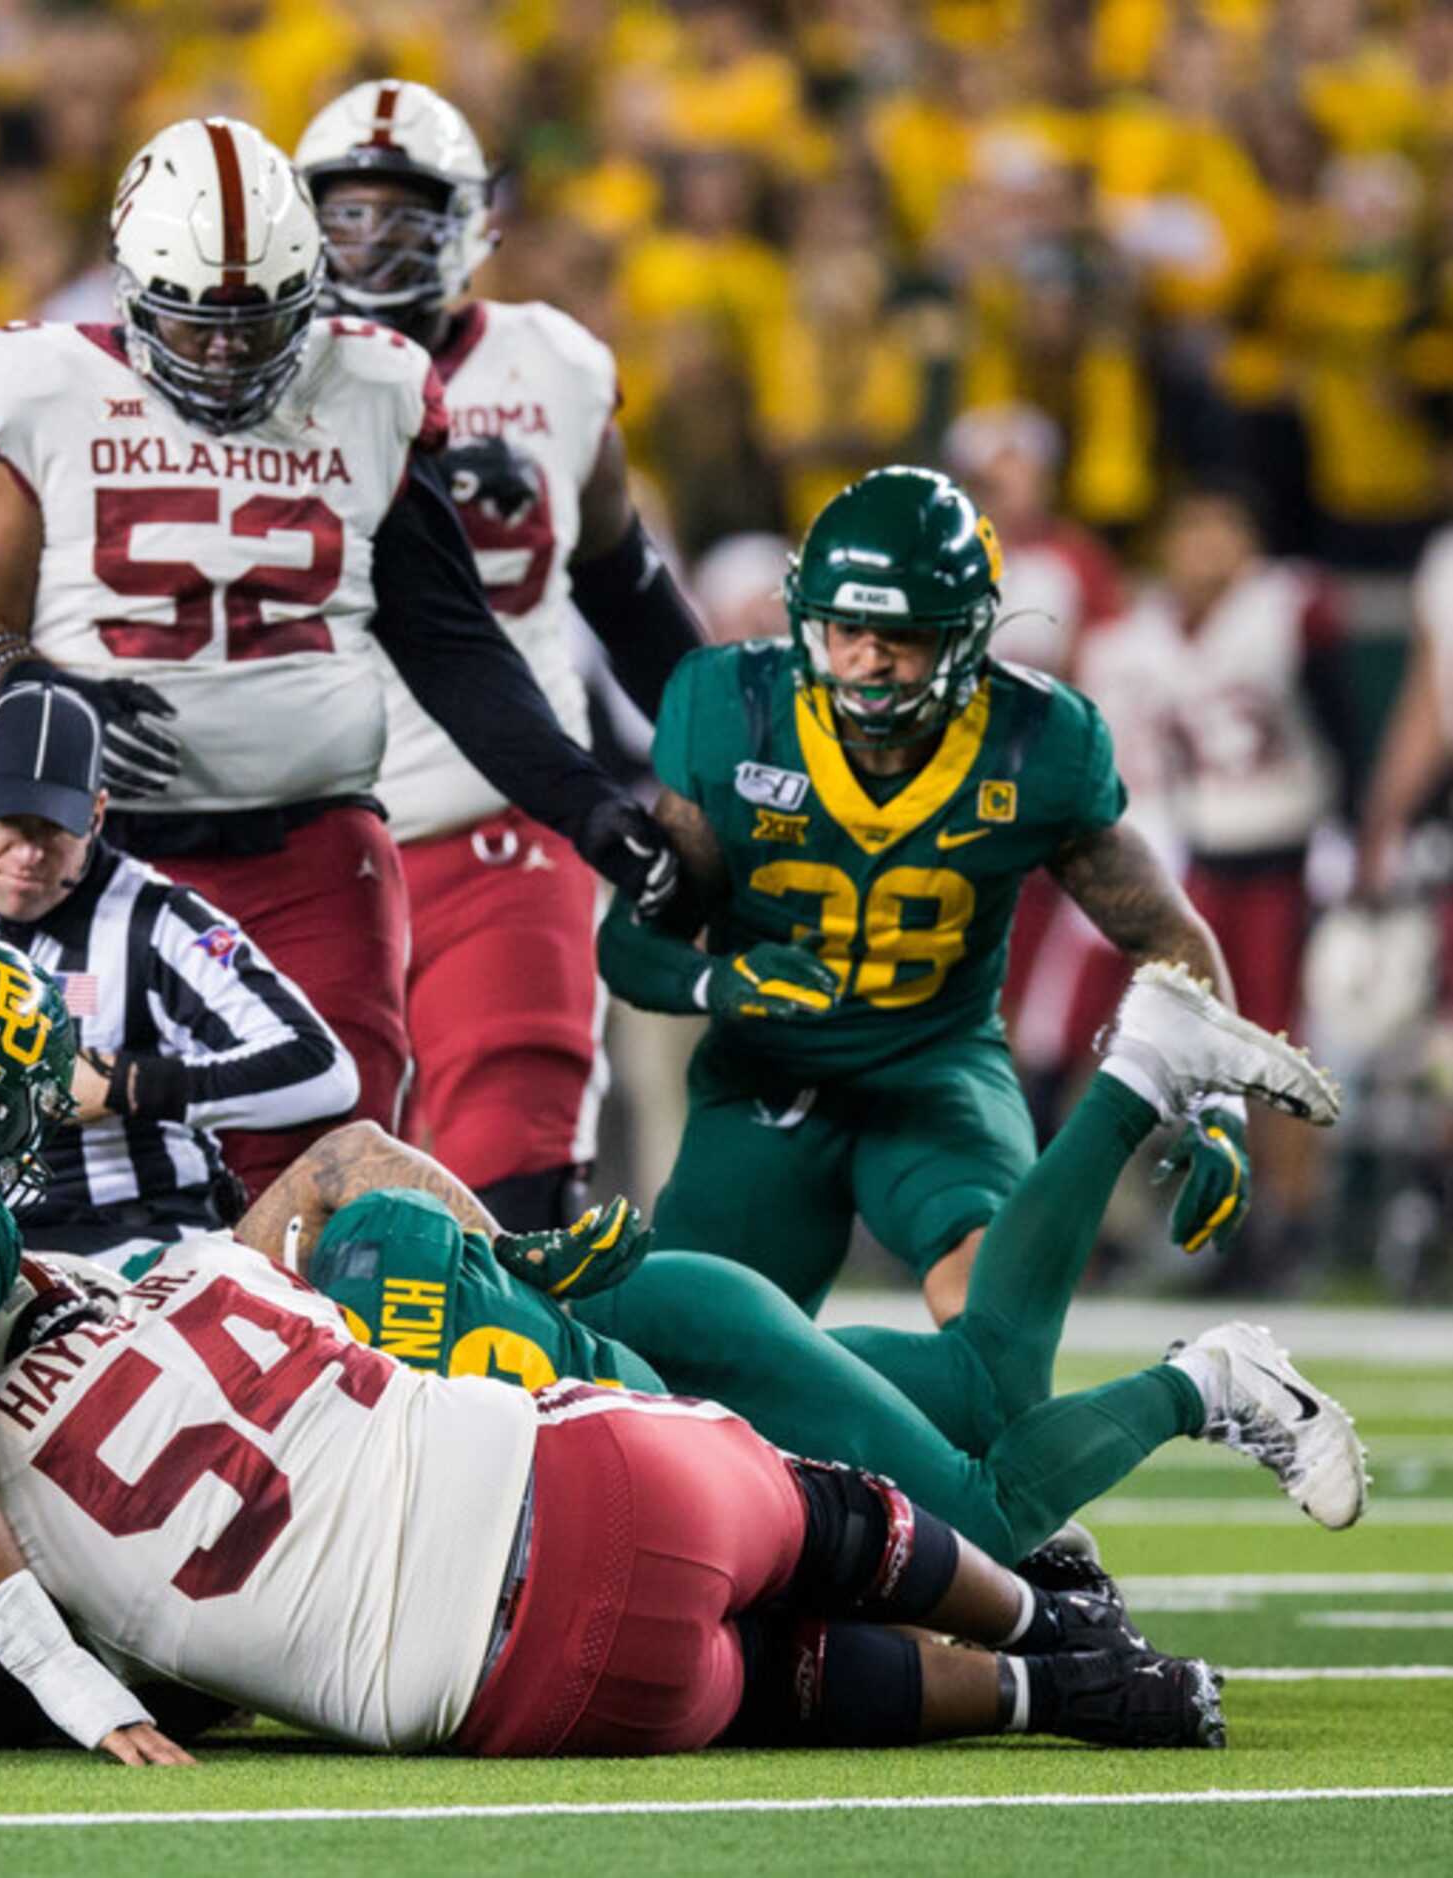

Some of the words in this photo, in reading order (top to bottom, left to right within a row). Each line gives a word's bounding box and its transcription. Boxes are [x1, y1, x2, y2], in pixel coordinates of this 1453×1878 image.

[90, 437, 352, 487] OKLAHOMA
[93, 487, 344, 662] 52
[985, 783, 1010, 816] C
[749, 860, 977, 1009] 38
[379, 1278, 446, 1362] NCH
[30, 1273, 397, 1601] 54
